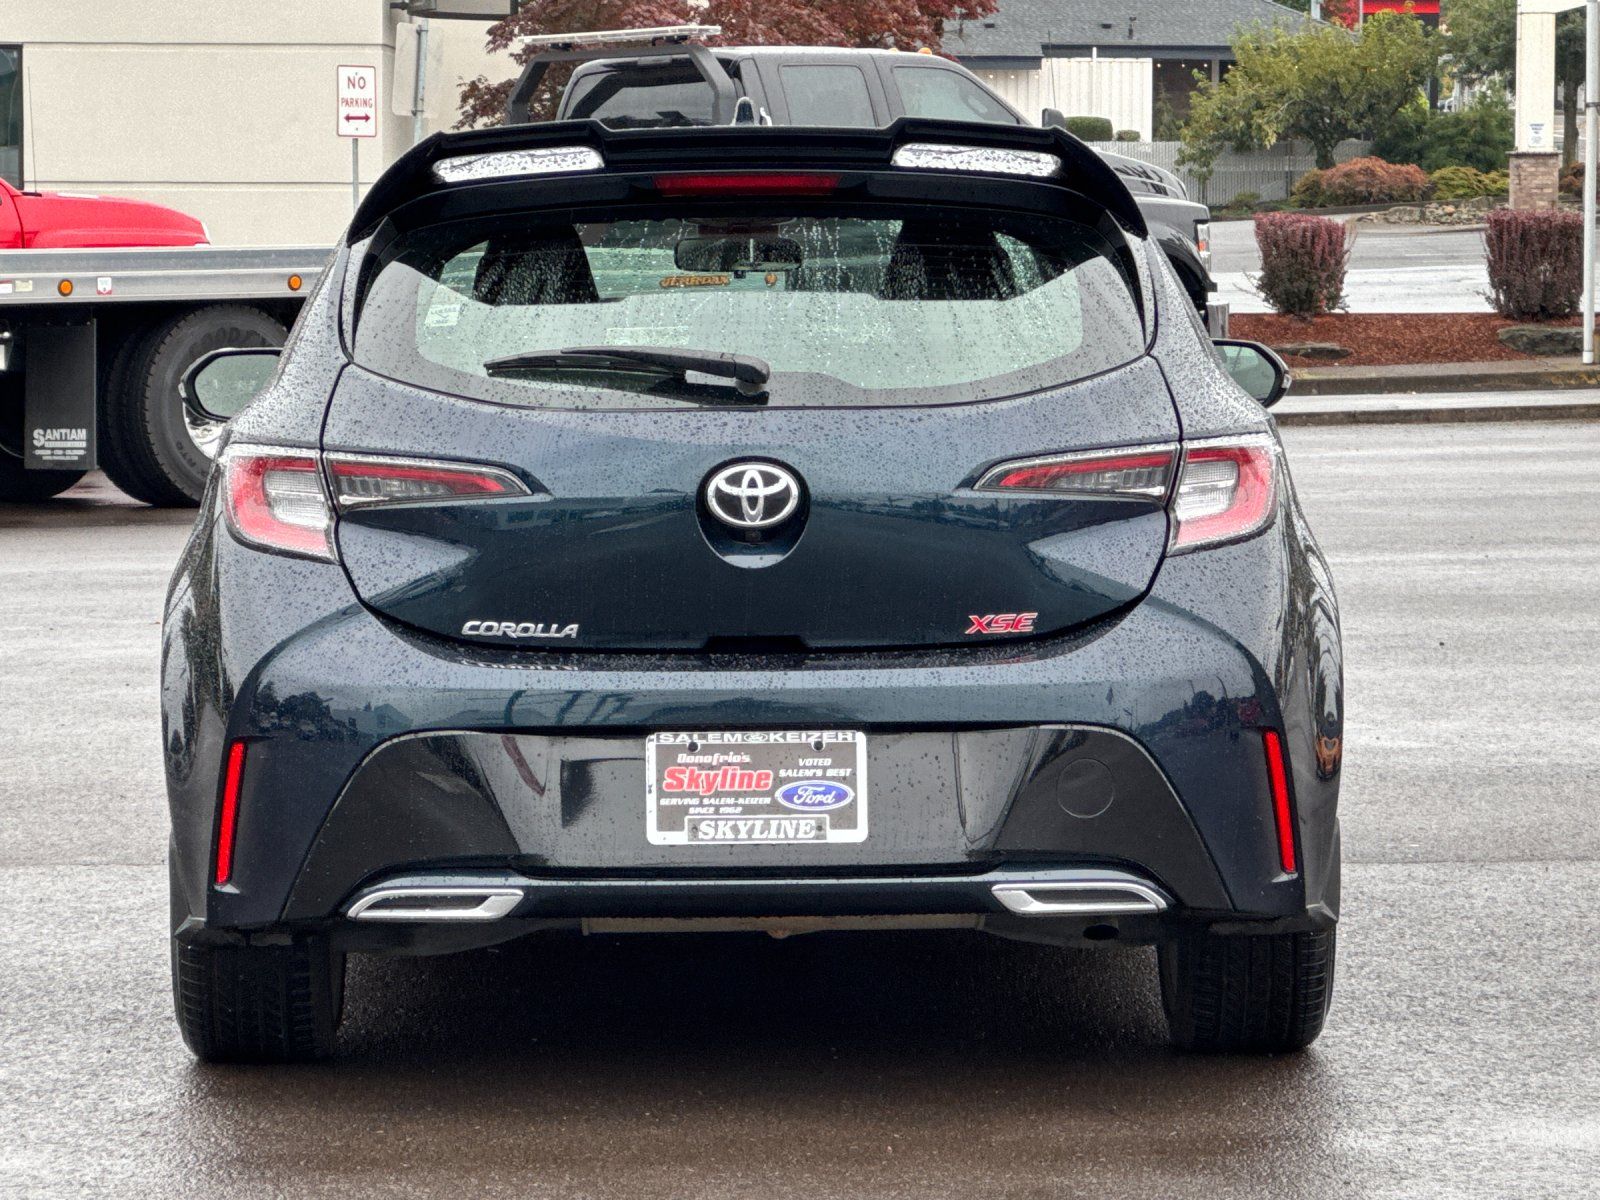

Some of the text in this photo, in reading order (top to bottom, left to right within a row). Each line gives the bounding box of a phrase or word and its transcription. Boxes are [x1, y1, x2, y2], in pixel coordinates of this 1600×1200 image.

[347, 76, 366, 90] NO
[341, 97, 373, 109] PARKING
[32, 428, 87, 447] SANTIAM
[461, 620, 579, 639] COROLLA
[965, 612, 1038, 634] XSE
[659, 732, 853, 743] SALEM KEIZER
[798, 758, 832, 766] VOTED
[662, 766, 773, 795] Skyline
[779, 768, 853, 777] SALEM'S BEST
[660, 797, 700, 805] SERVING
[793, 785, 836, 805] Ford
[698, 820, 816, 840] SKYLINE
